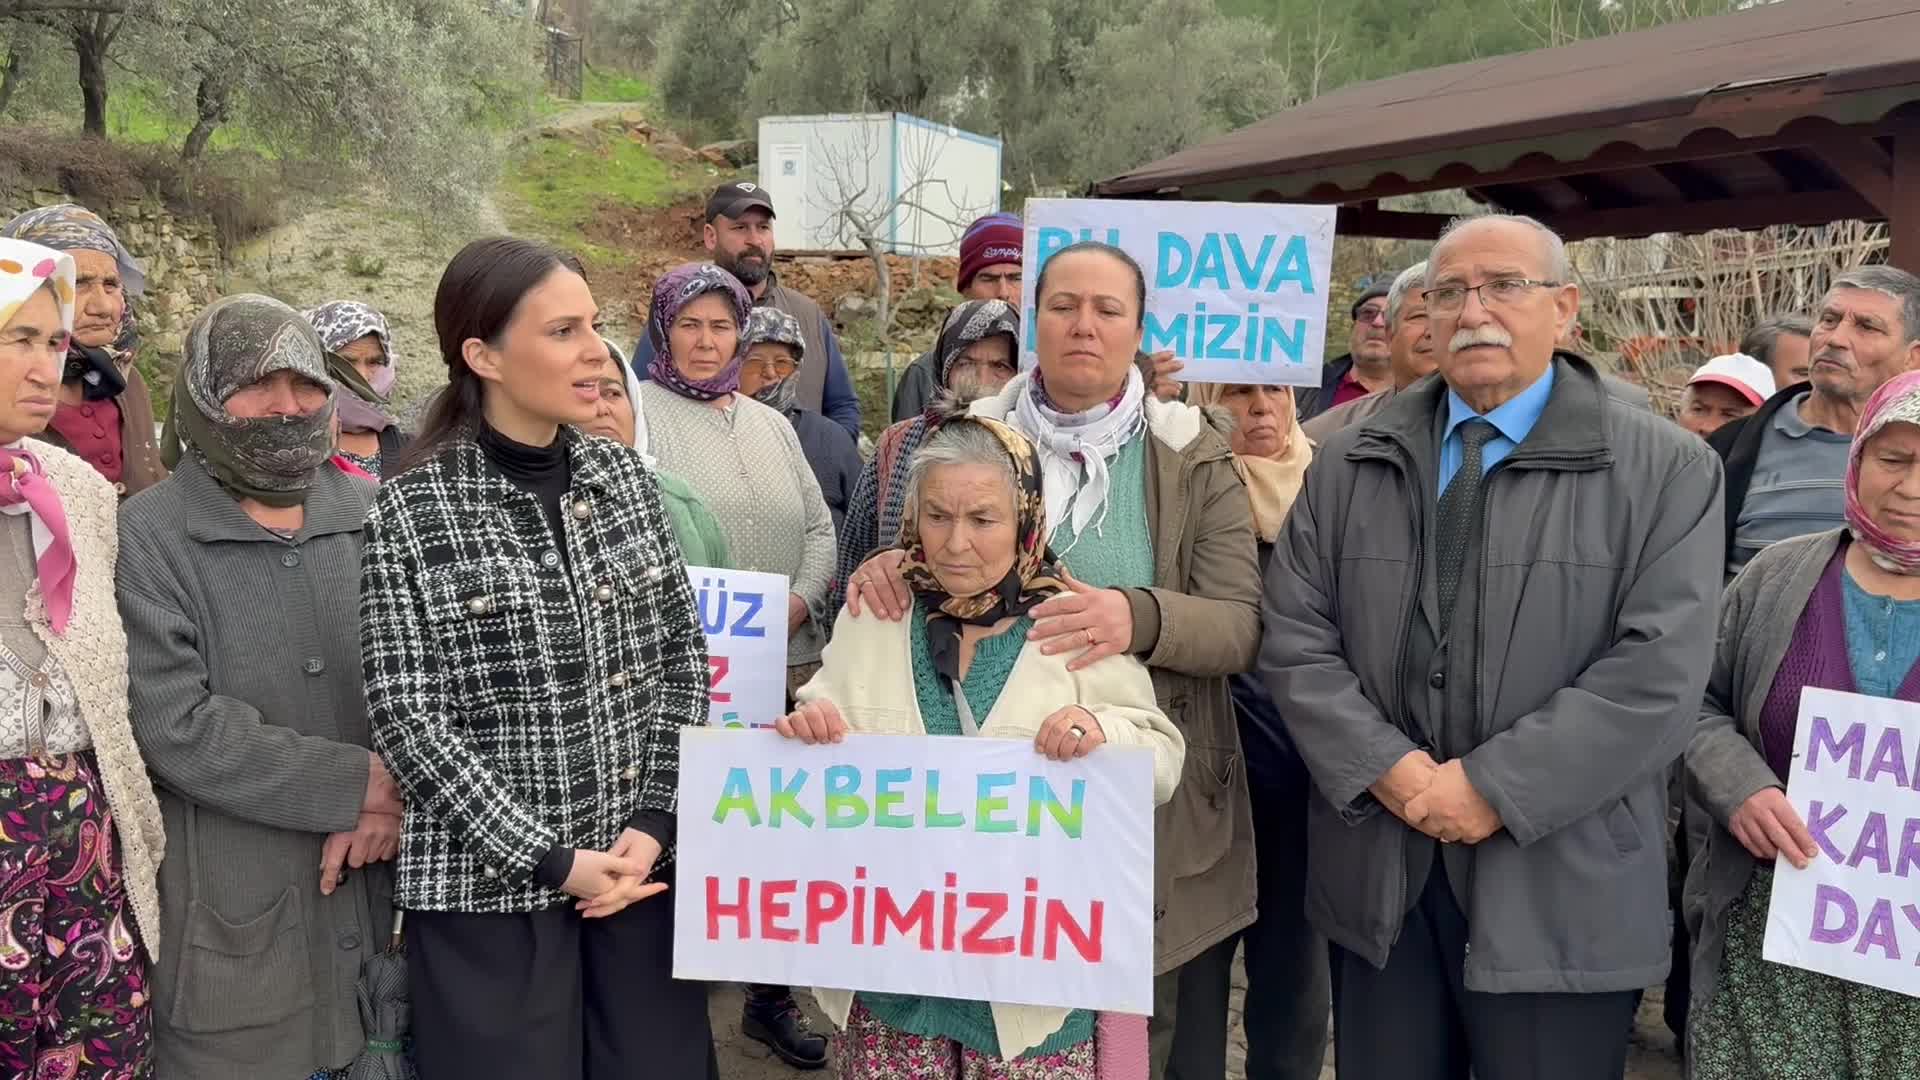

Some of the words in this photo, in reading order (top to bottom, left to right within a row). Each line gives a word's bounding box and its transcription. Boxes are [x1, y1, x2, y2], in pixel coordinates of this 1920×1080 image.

[1154, 231, 1315, 294] DAVA
[1805, 716, 1920, 791] MA
[712, 764, 1087, 839] AKBELEN
[705, 866, 1104, 963] HEPİMİZİN
